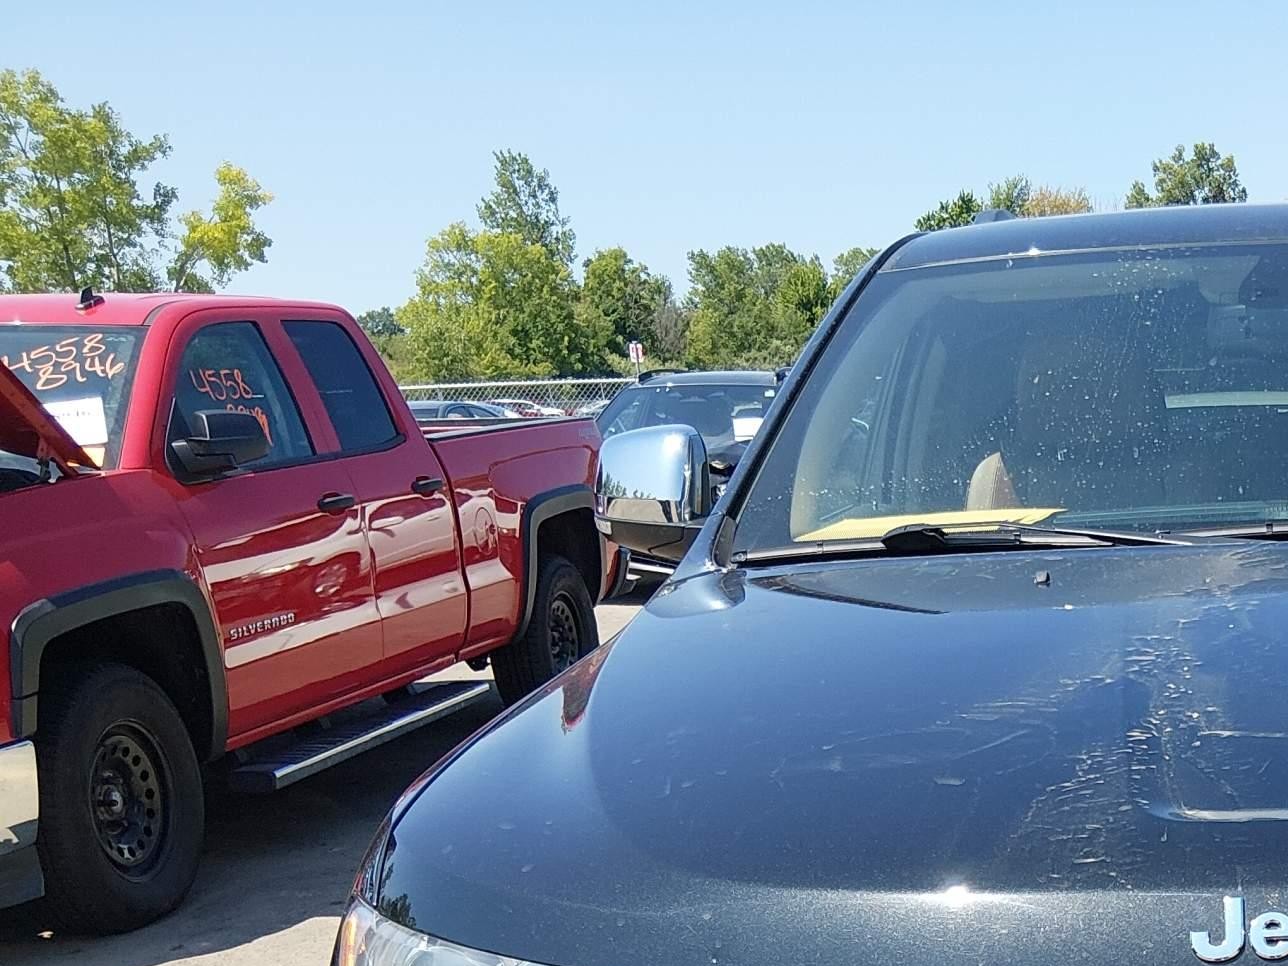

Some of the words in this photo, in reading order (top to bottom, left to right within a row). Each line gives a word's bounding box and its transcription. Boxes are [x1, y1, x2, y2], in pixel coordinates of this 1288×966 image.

[2, 333, 106, 373] 4558
[36, 353, 125, 390] 8946
[189, 368, 253, 400] 4558
[230, 612, 296, 641] SILVERADO
